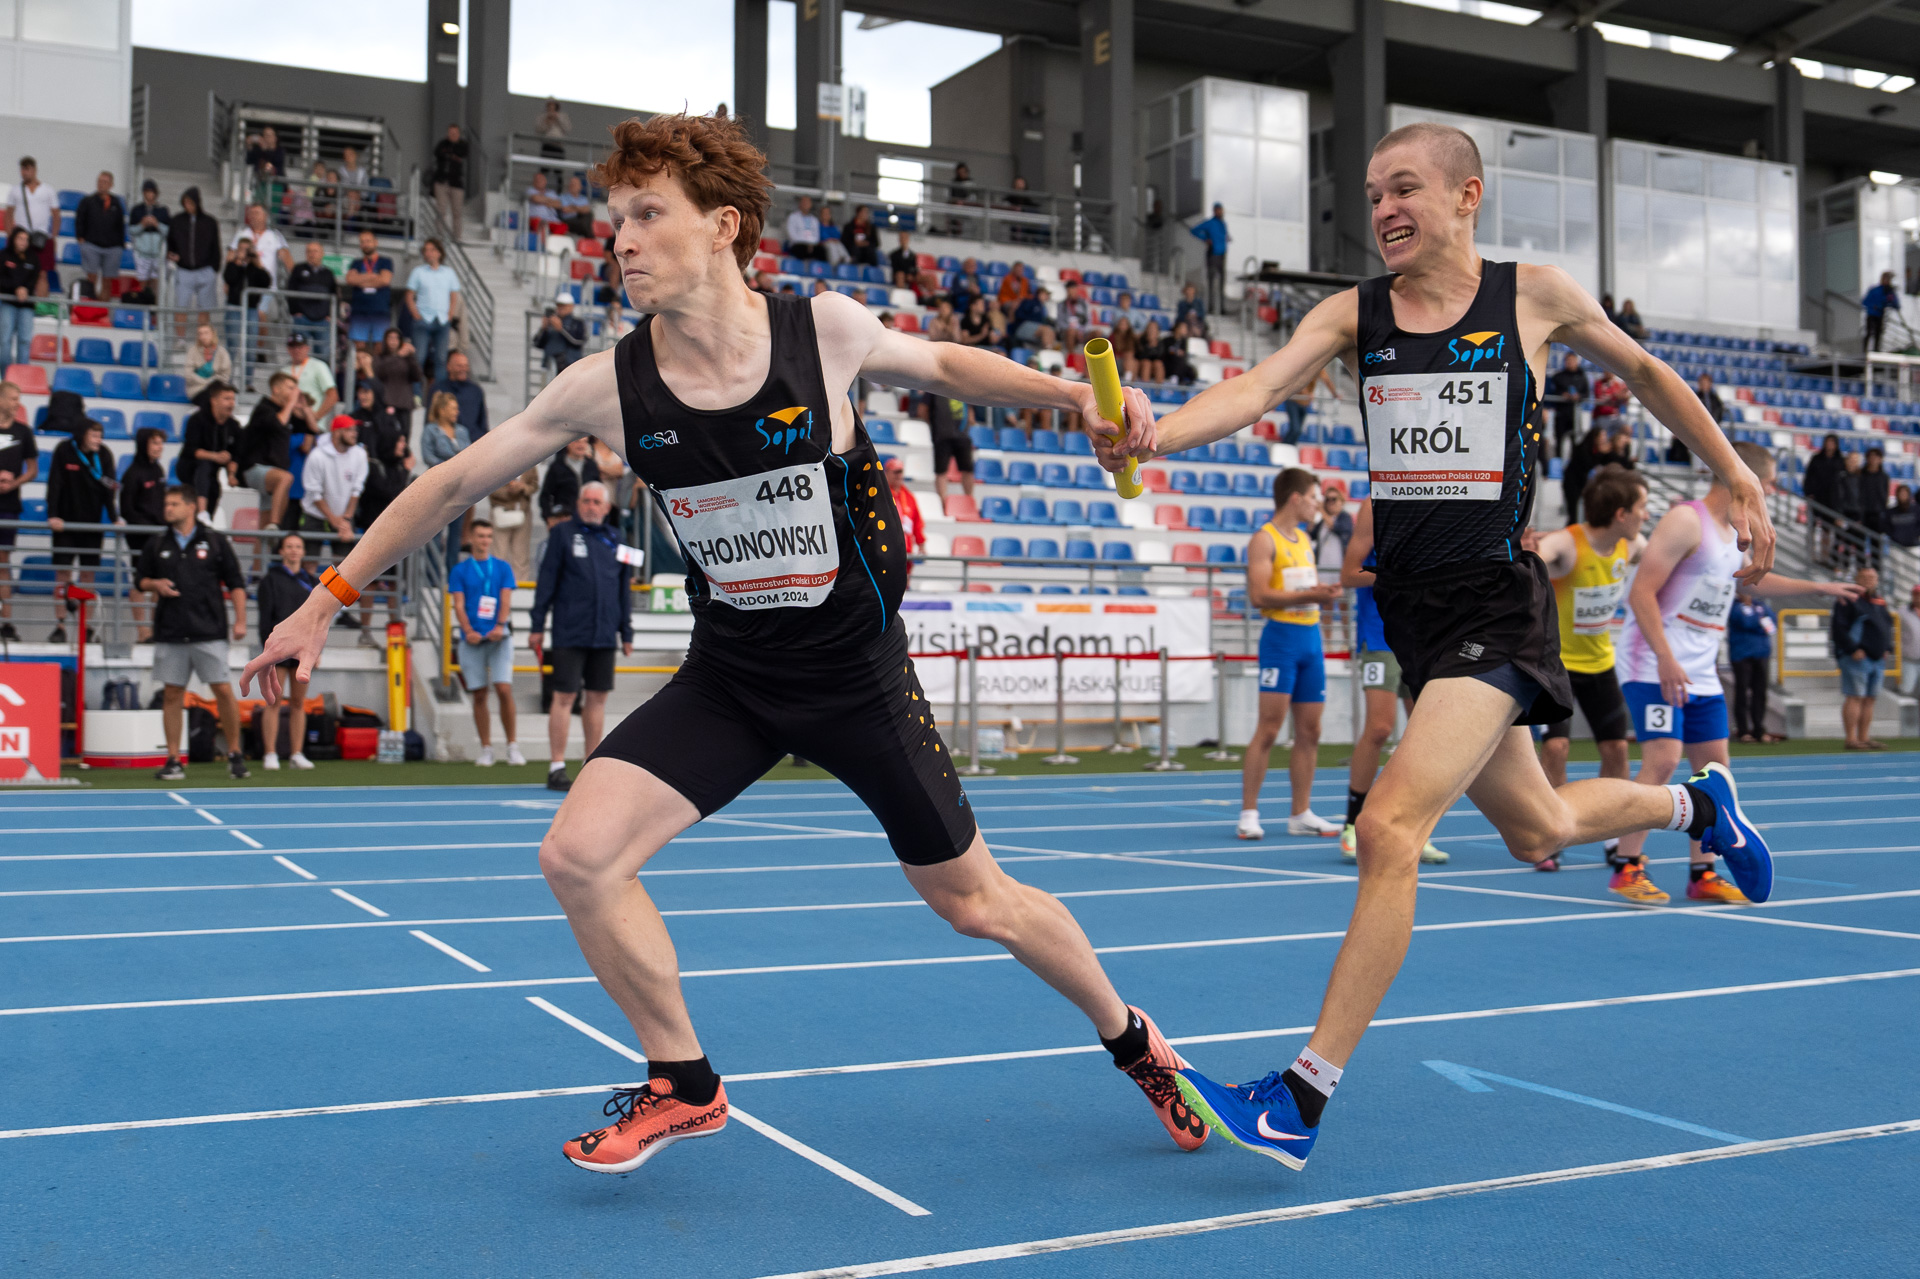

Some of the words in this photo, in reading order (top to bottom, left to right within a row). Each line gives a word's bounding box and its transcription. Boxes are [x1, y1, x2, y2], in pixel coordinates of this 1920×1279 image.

[1093, 31, 1110, 64] E
[1448, 334, 1505, 371] Sopot
[1438, 380, 1493, 404] 451
[755, 410, 814, 455] Sopot
[1390, 420, 1470, 454] KRÓL
[1402, 472, 1447, 480] Mistrzostwa
[1448, 472, 1473, 480] Polski
[1474, 472, 1491, 480] U20
[755, 474, 813, 504] 448
[1391, 486, 1434, 496] RADOM
[1436, 485, 1469, 496] 2024
[688, 524, 828, 567] CHOJNOWSKI
[739, 578, 790, 591] Mistrzostwa
[790, 576, 810, 585] Polski
[811, 575, 829, 585] U20
[781, 591, 809, 602] 2024
[977, 675, 1048, 692] RADOM
[1057, 675, 1161, 693] ASKAKUJE
[1264, 668, 1274, 684] 2
[1368, 663, 1378, 682] 8
[1651, 707, 1666, 729] 3
[638, 1129, 667, 1151] new
[669, 1103, 727, 1134] balance
